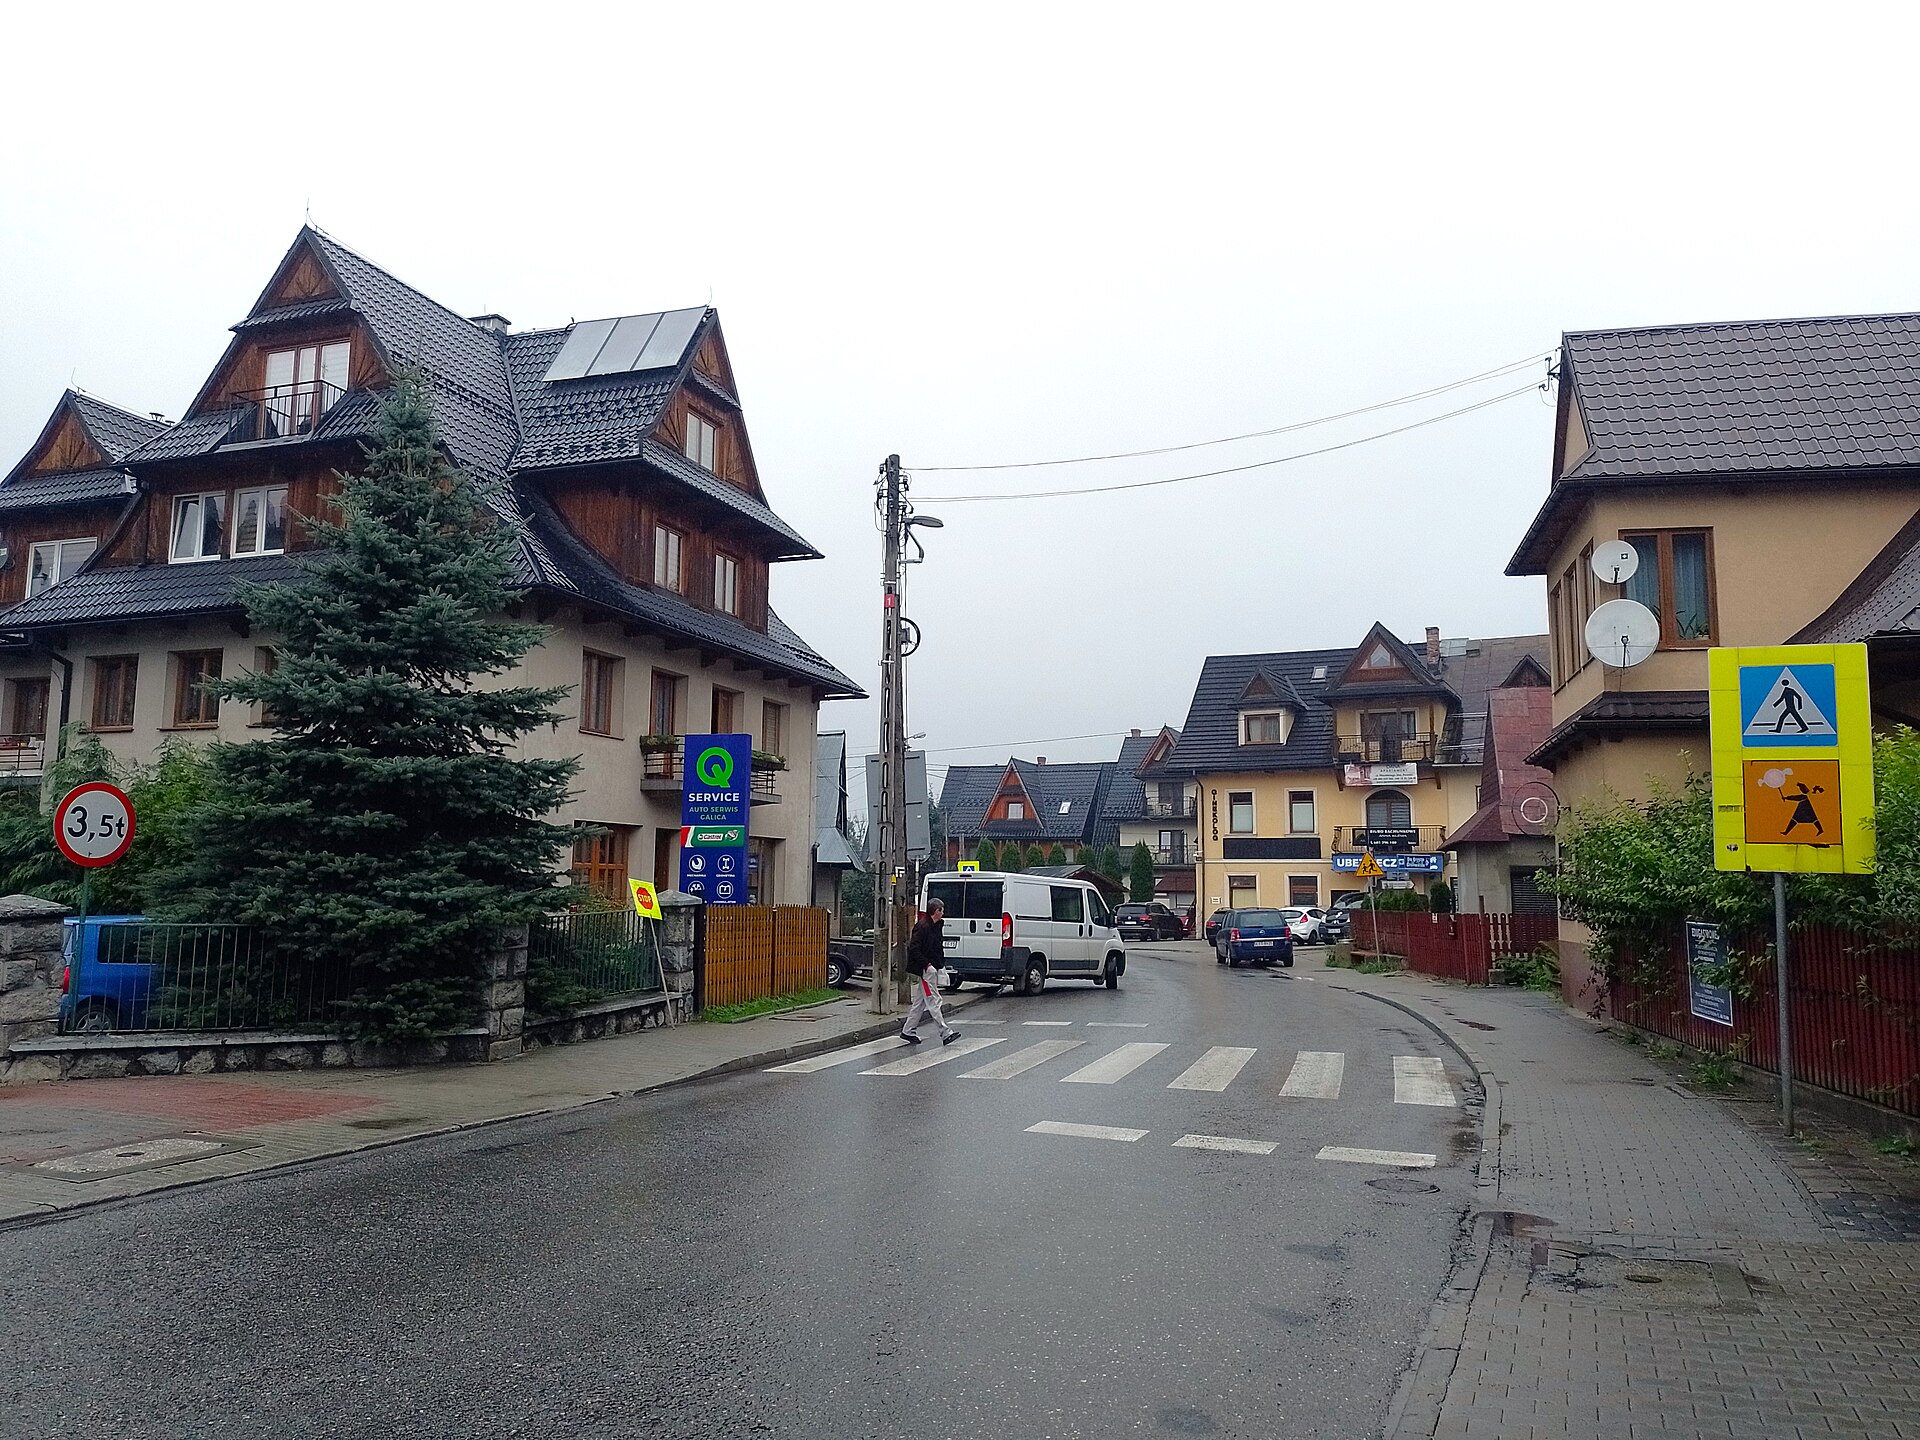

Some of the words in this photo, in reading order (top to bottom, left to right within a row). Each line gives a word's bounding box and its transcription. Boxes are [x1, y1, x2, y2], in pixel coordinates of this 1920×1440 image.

[688, 792, 740, 802] SERVICE
[67, 805, 125, 843] 3,5t
[637, 893, 652, 904] STOP
